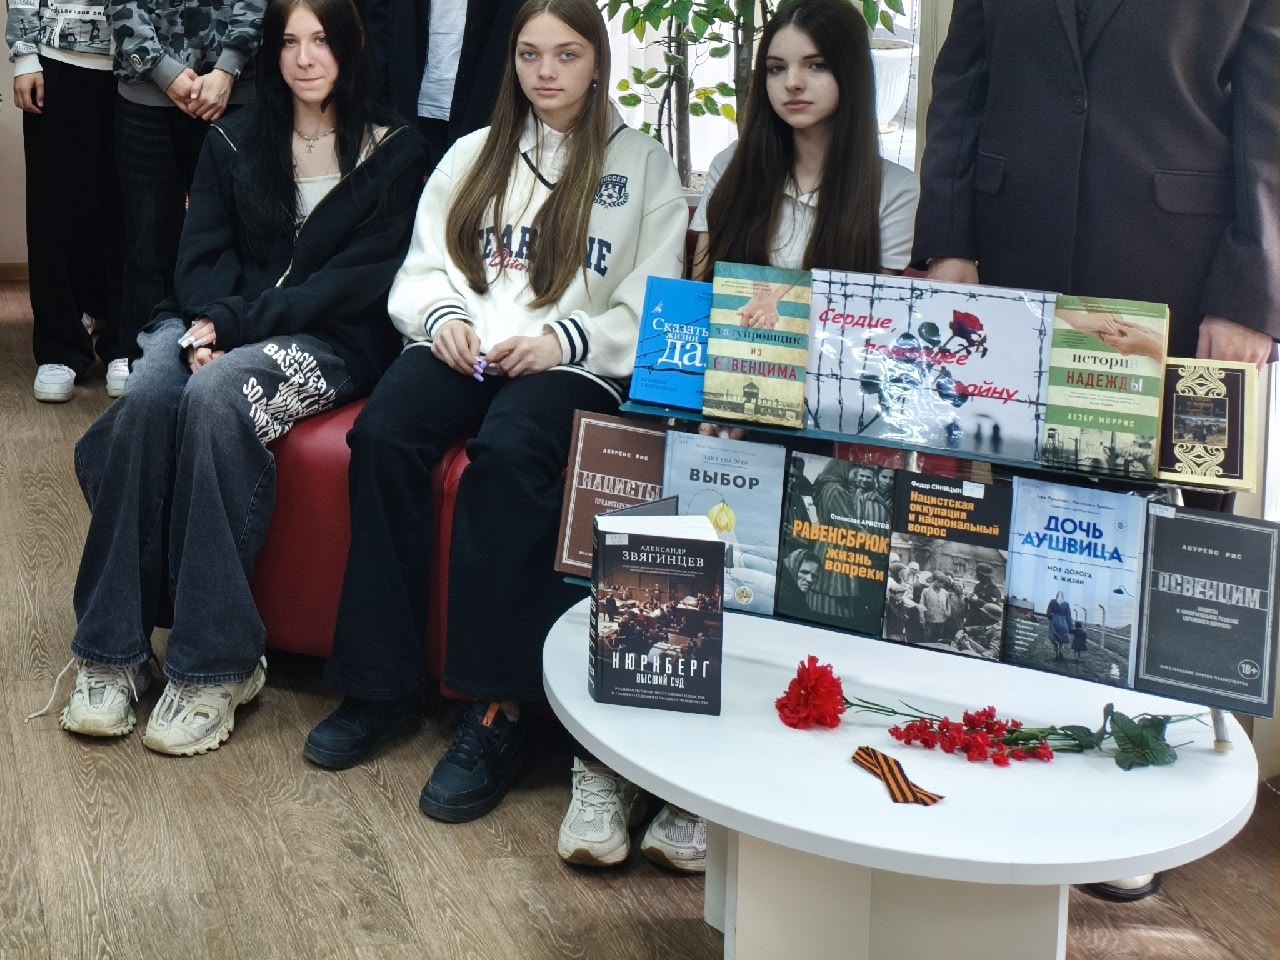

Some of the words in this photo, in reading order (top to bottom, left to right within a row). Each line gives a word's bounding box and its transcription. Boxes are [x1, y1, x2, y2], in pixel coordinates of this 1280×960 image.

[652, 317, 709, 337] Сказать
[819, 308, 897, 333] Сердце,
[1066, 370, 1144, 392] НАДЕЖДЫ
[1098, 416, 1135, 427] МОРРИС
[582, 471, 660, 501] НАЦИСТЫ
[689, 467, 760, 490] ВЫБОР
[909, 503, 967, 520] оккупация
[910, 490, 975, 511] Нацистская
[907, 523, 947, 537] вопрос
[908, 513, 916, 522] и
[918, 514, 999, 536] национальный
[1043, 515, 1104, 540] ДОЧЬ
[792, 519, 890, 555] РАВЕНСБРЮК
[1021, 530, 1124, 564] АУШВИЦА
[622, 550, 705, 568] ЗВЯГИНЦЕВ
[640, 544, 687, 554] АЛЕКСАНДР
[825, 547, 872, 566] жизнь
[824, 559, 885, 582] вопреки
[1158, 571, 1261, 609] ОСВЕНЦИМ
[612, 652, 710, 678] НЮРНБЕРГ
[636, 672, 668, 686] ВЫСШИЙ
[670, 676, 685, 689] СУД
